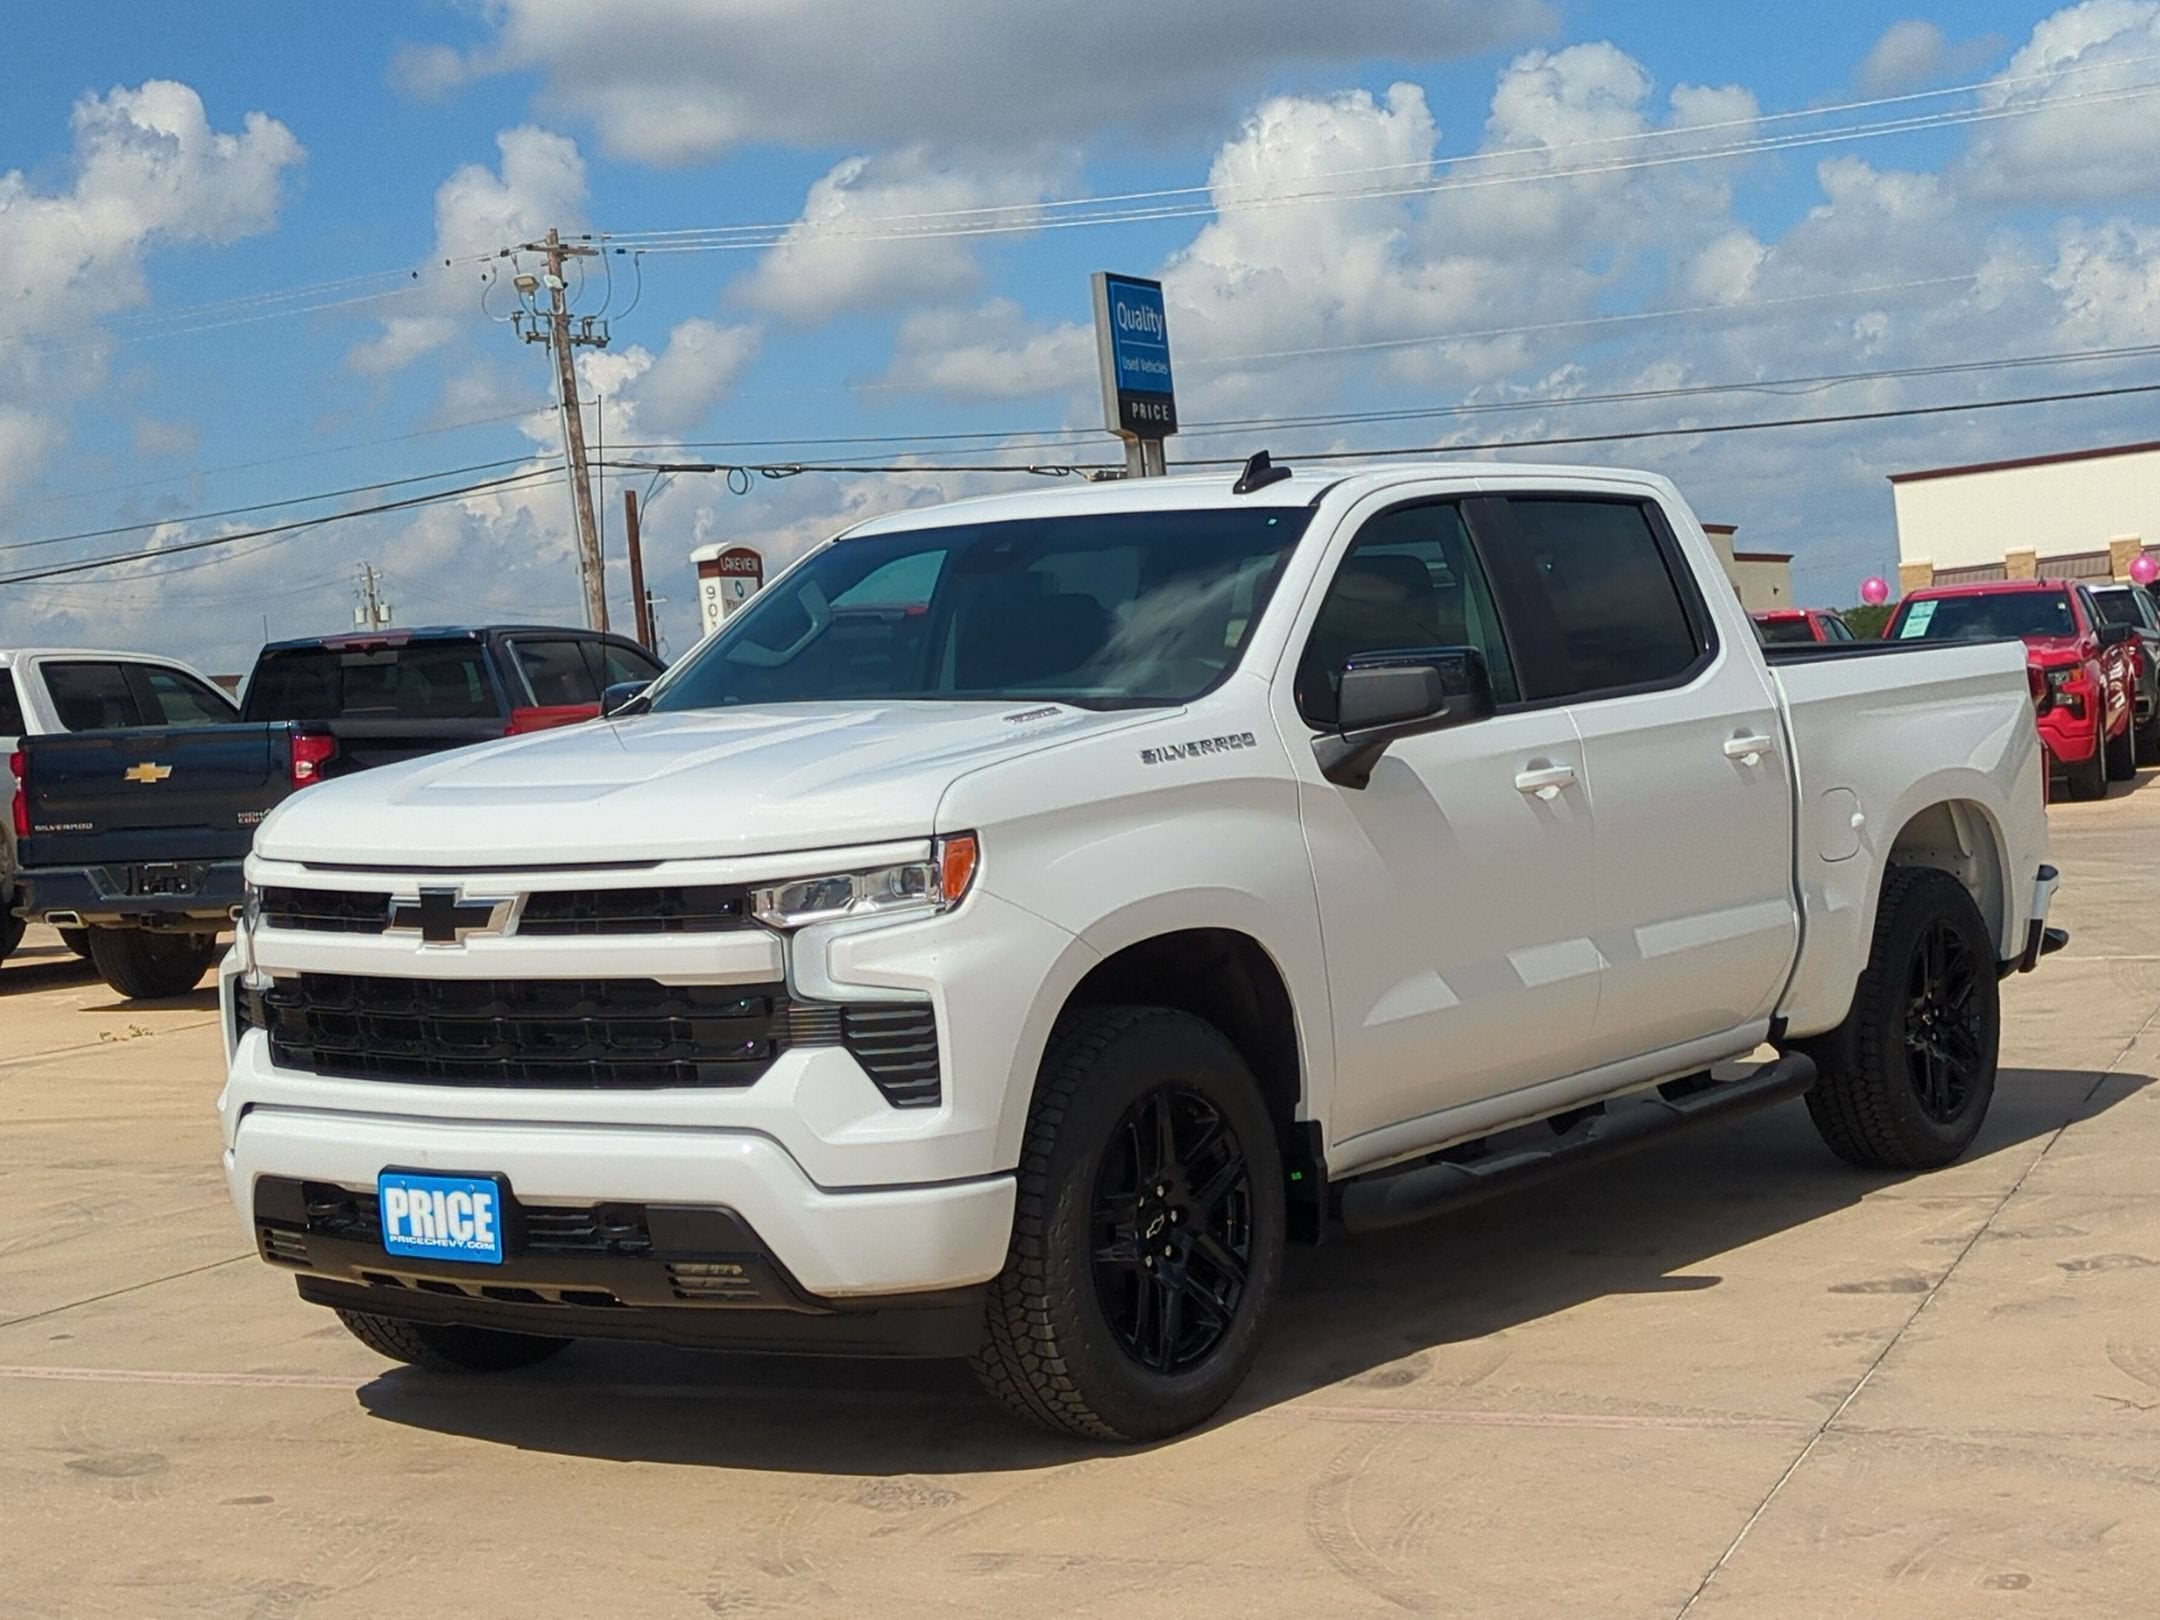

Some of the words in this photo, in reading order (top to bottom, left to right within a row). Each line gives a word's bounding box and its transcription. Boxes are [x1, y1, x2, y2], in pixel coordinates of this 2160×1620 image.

[1117, 302, 1162, 340] Quality
[1122, 356, 1140, 373] Used
[1141, 359, 1168, 375] Vehicles
[1132, 403, 1169, 421] PRICE
[1141, 732, 1256, 765] SILVERADO
[384, 1187, 495, 1243] PRICE
[389, 1235, 496, 1252] PRICECHEVY.COM
